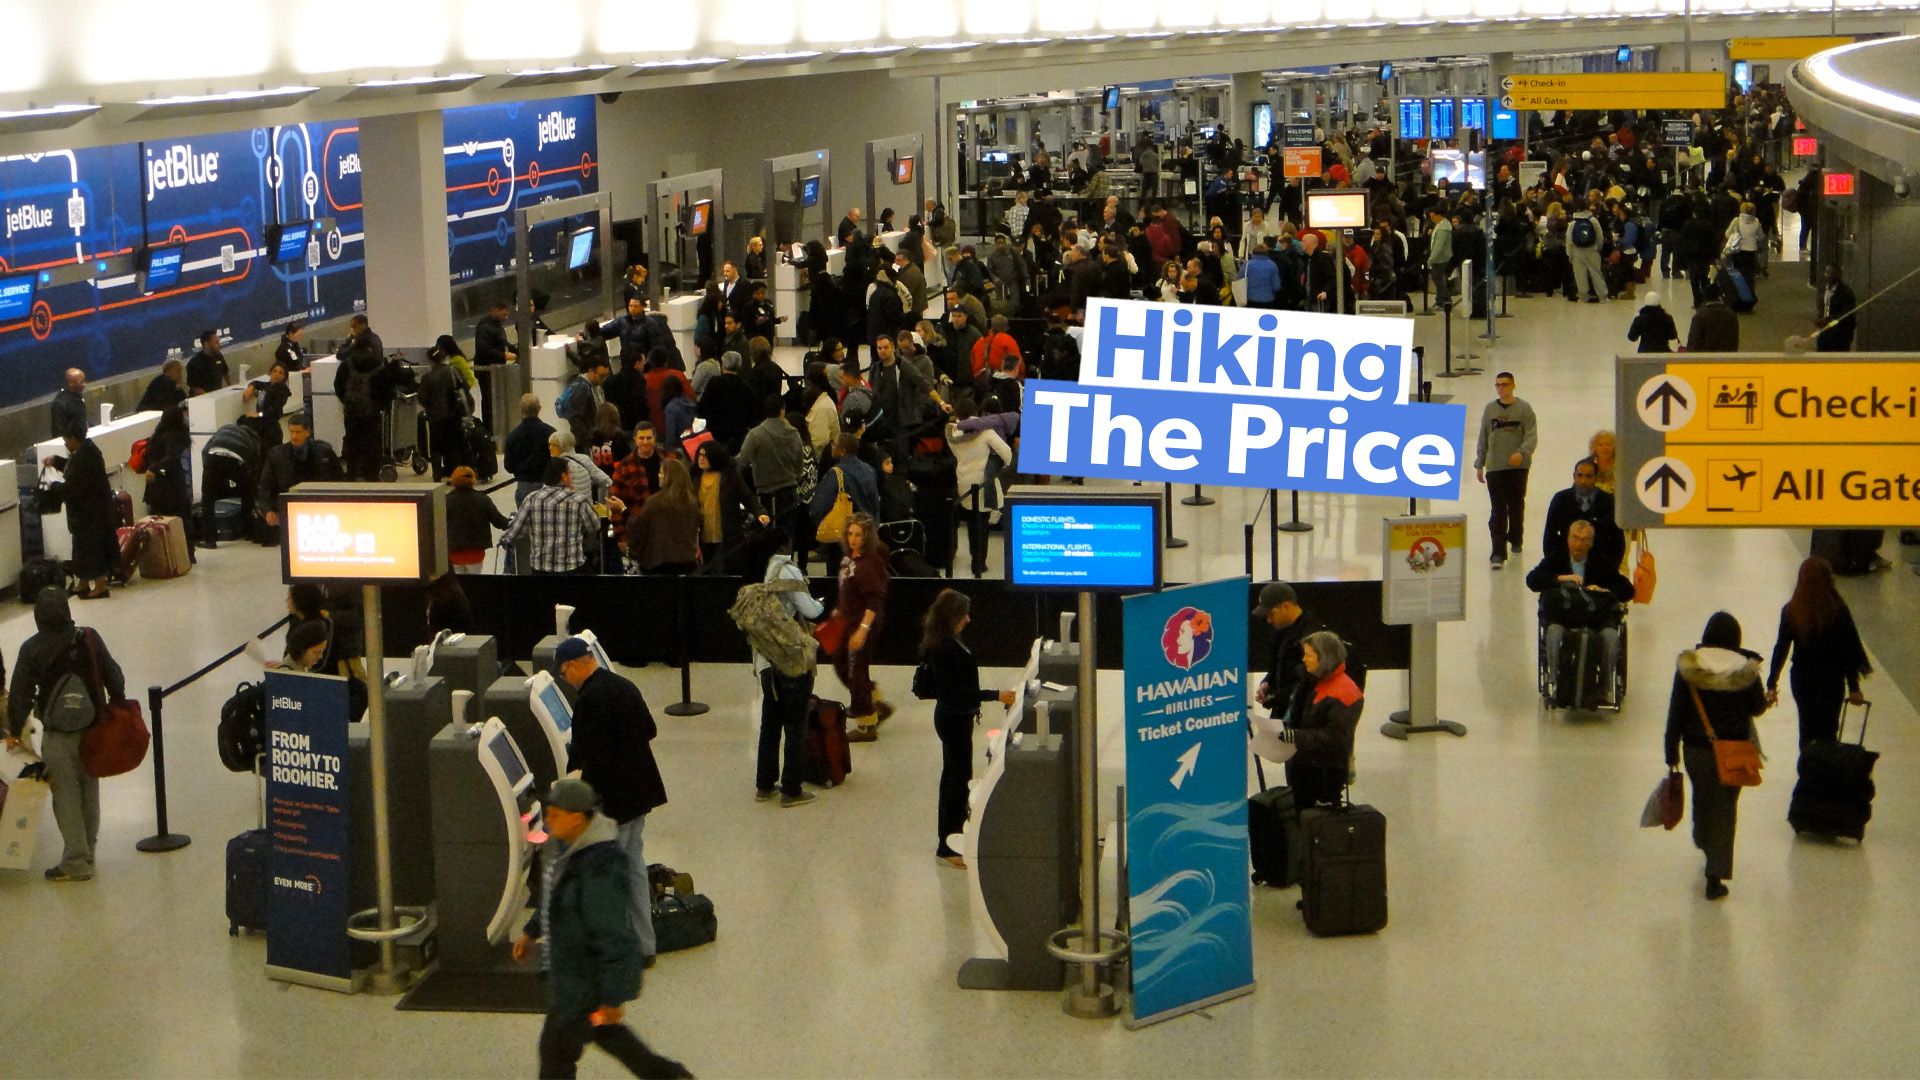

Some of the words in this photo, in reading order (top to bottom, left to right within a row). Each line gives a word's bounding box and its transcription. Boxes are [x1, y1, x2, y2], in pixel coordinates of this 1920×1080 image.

[1530, 79, 1566, 87] Check-in
[1544, 97, 1568, 105] Gates
[538, 111, 576, 151] jetBlue
[147, 144, 219, 201] jetBlue
[339, 154, 362, 179] jetBlu
[6, 204, 53, 239] jetBlue
[3, 284, 31, 297] SERVICE
[1774, 386, 1917, 418] Check-i
[1772, 469, 1825, 501] All
[1840, 470, 1920, 501] Gat
[1137, 667, 1239, 704] HAWAIIAN
[272, 696, 302, 711] jetBlue
[1165, 695, 1214, 715] AIRLINES
[1138, 721, 1182, 742] Ticket
[1185, 711, 1240, 731] Counter
[272, 730, 310, 751] FROM
[272, 748, 321, 770] ROOMY
[322, 755, 340, 773] TO
[272, 766, 339, 791] ROOMIER.
[274, 876, 293, 888] EVEN
[294, 880, 314, 892] MORE
